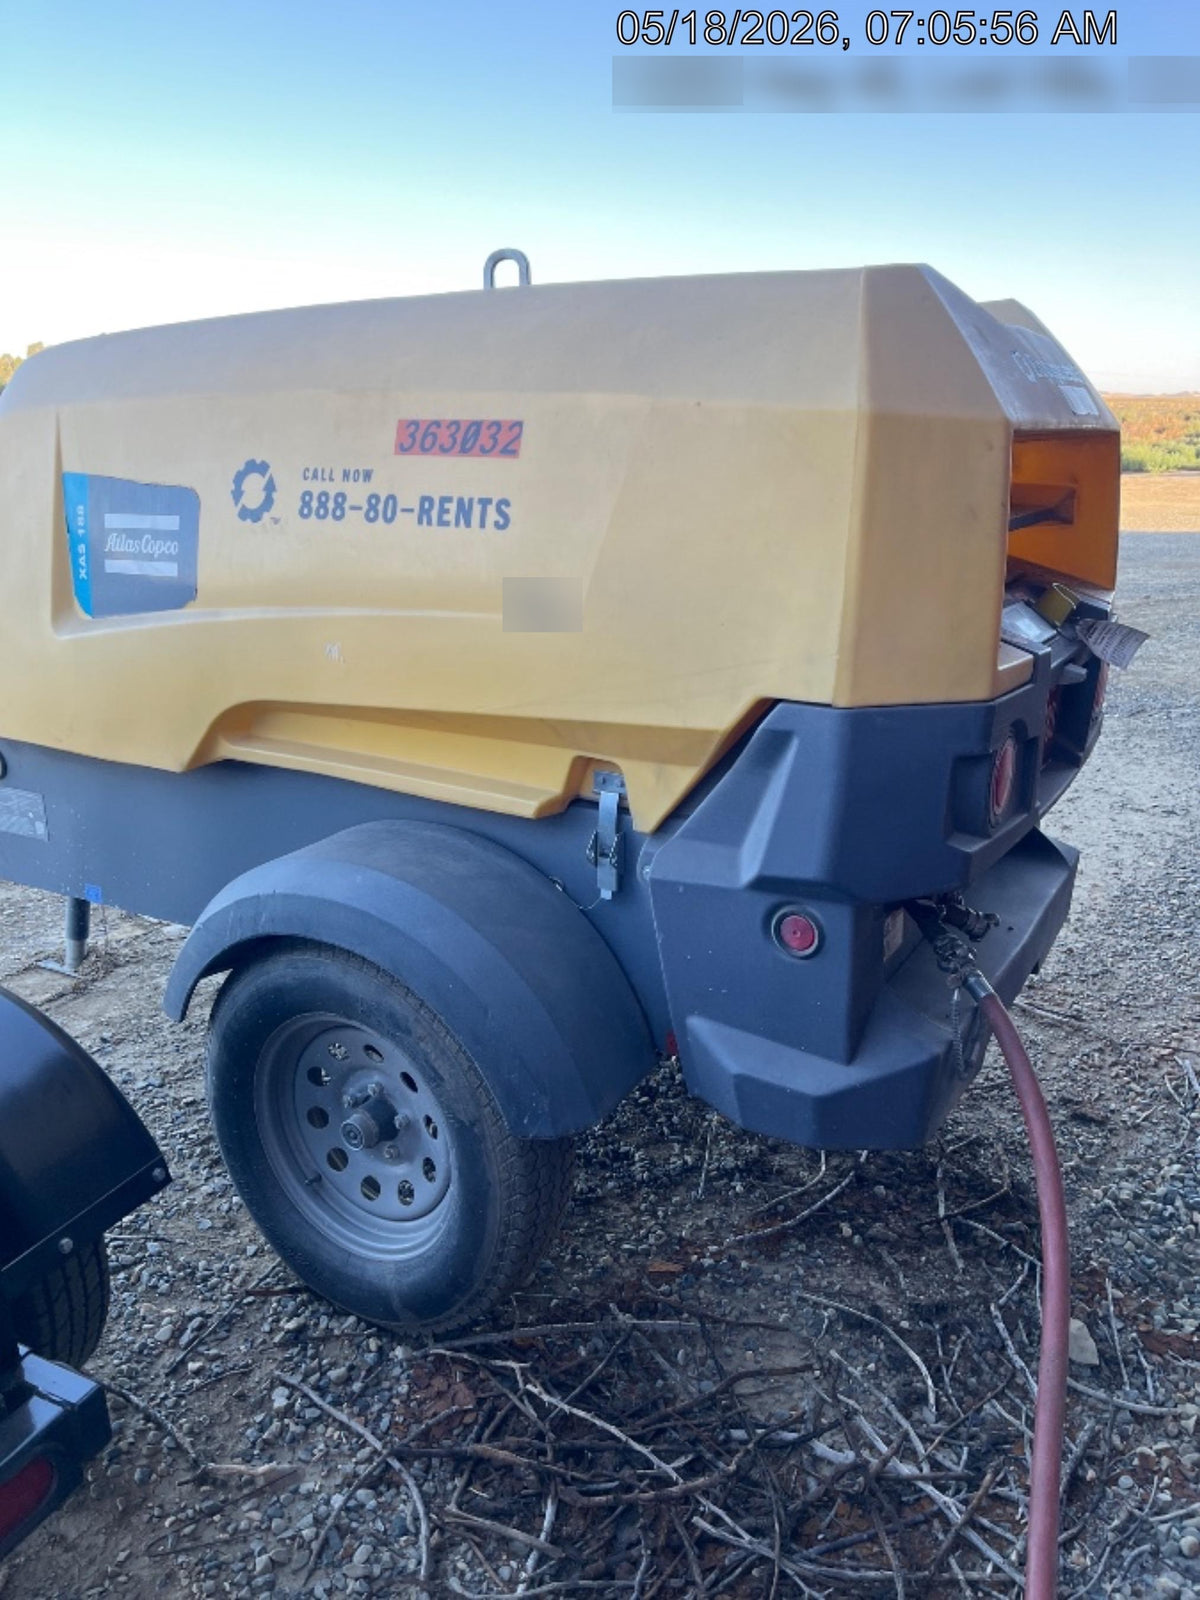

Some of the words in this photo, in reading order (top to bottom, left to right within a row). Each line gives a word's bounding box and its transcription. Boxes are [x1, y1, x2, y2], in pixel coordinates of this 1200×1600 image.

[398, 419, 524, 456] 363032
[302, 467, 335, 482] CALL
[342, 468, 374, 483] NOW
[298, 489, 512, 531] 888-80-RENTS
[78, 544, 88, 580] XAS
[104, 532, 140, 554] Atlas
[141, 533, 179, 559] Copco
